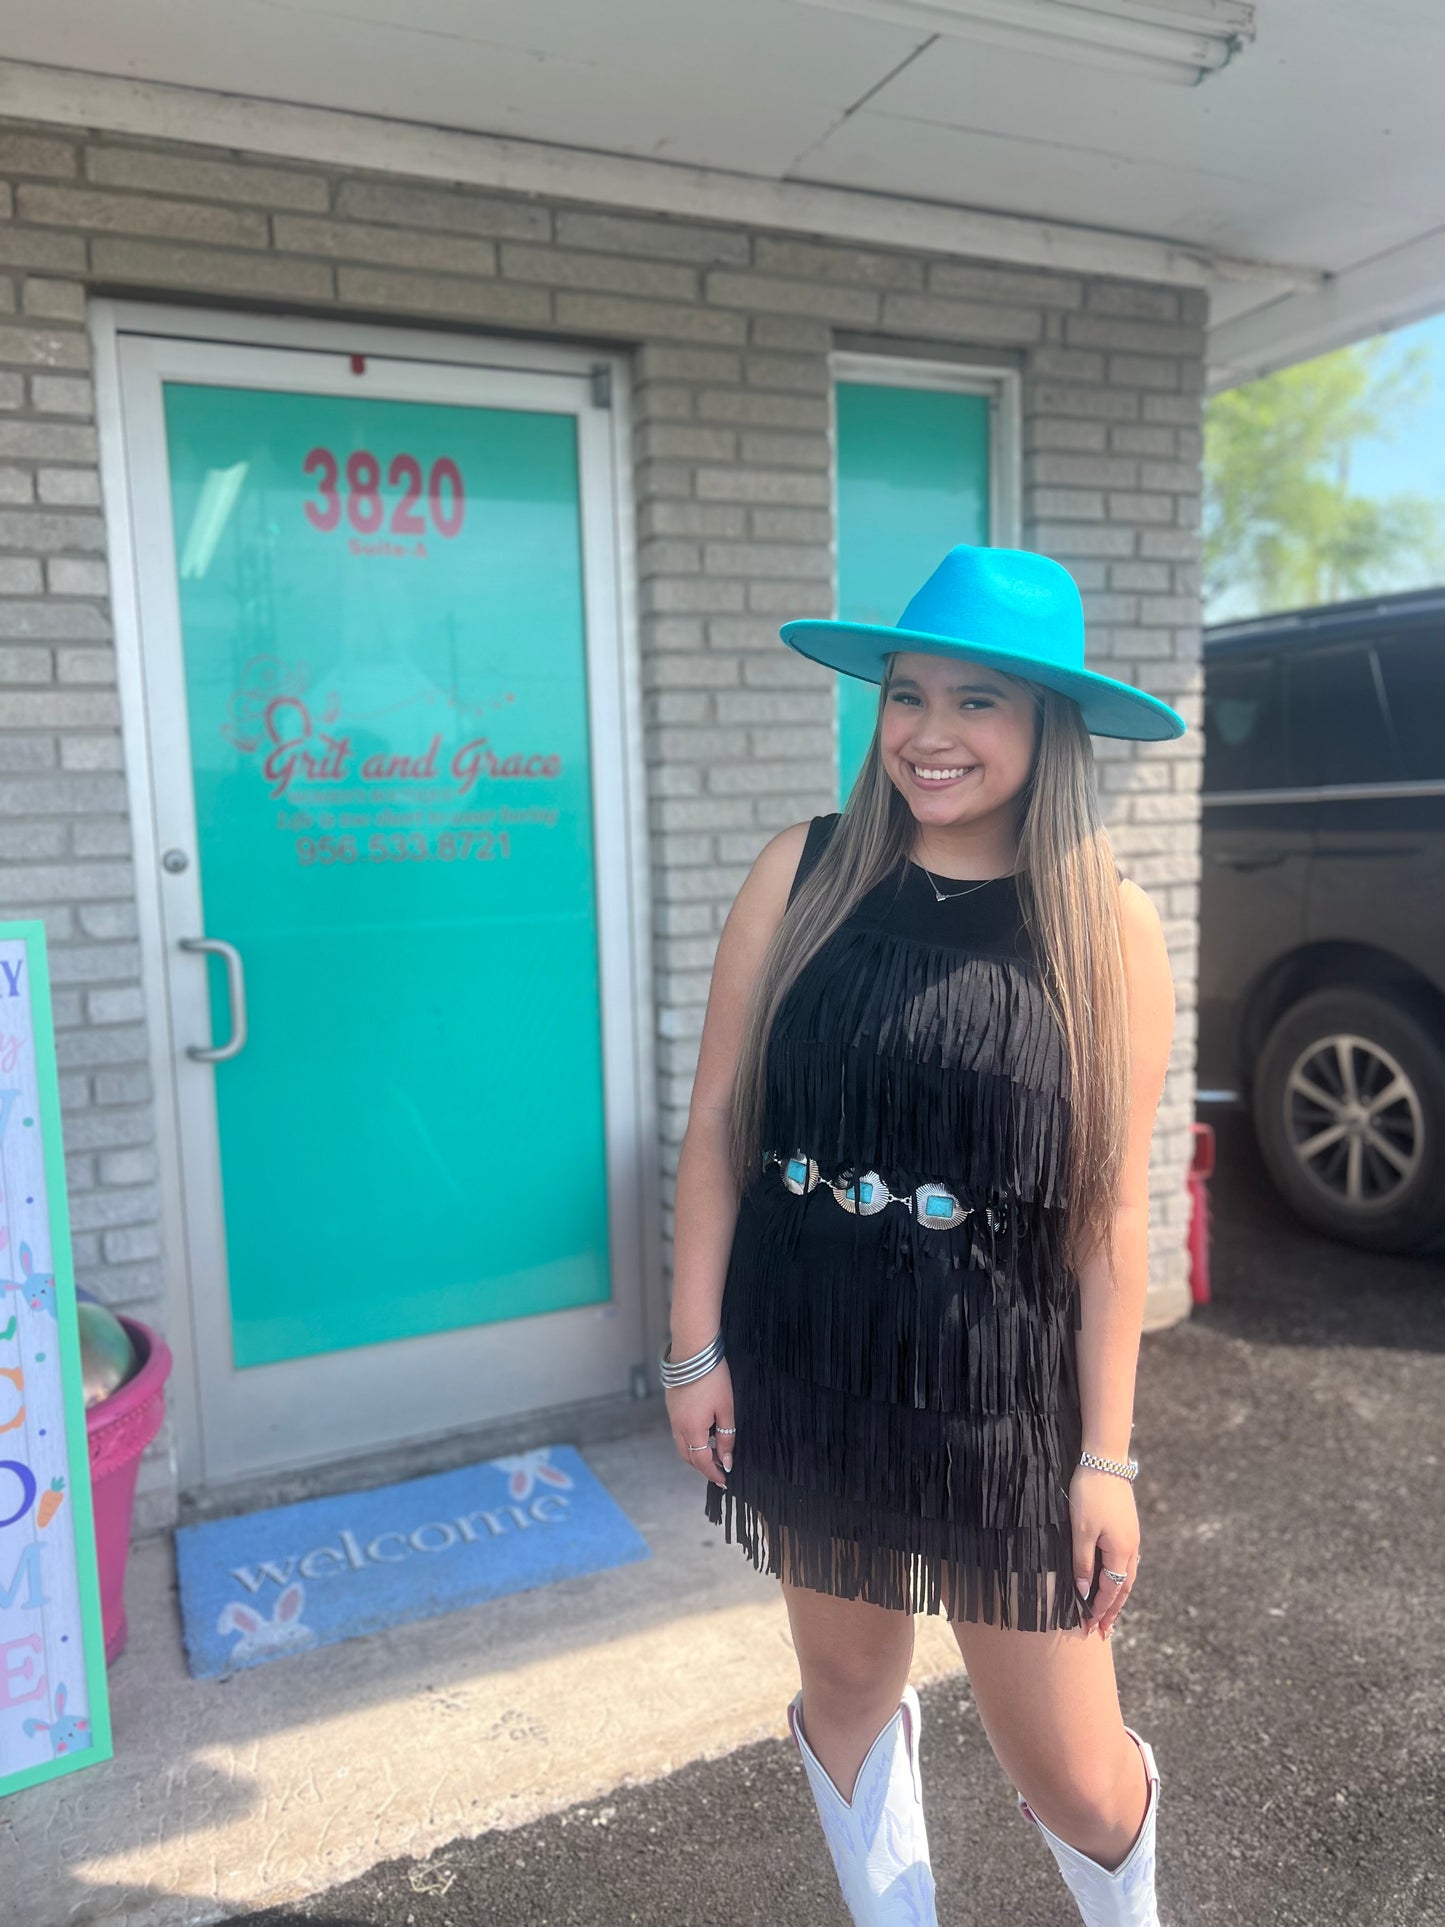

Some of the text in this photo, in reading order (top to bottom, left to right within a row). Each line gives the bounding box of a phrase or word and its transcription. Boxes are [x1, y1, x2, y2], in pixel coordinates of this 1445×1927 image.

[304, 448, 464, 537] 3820
[264, 734, 561, 798] Grit and Grace
[295, 831, 511, 866] 956.533.8721
[231, 1494, 569, 1592] welcome
